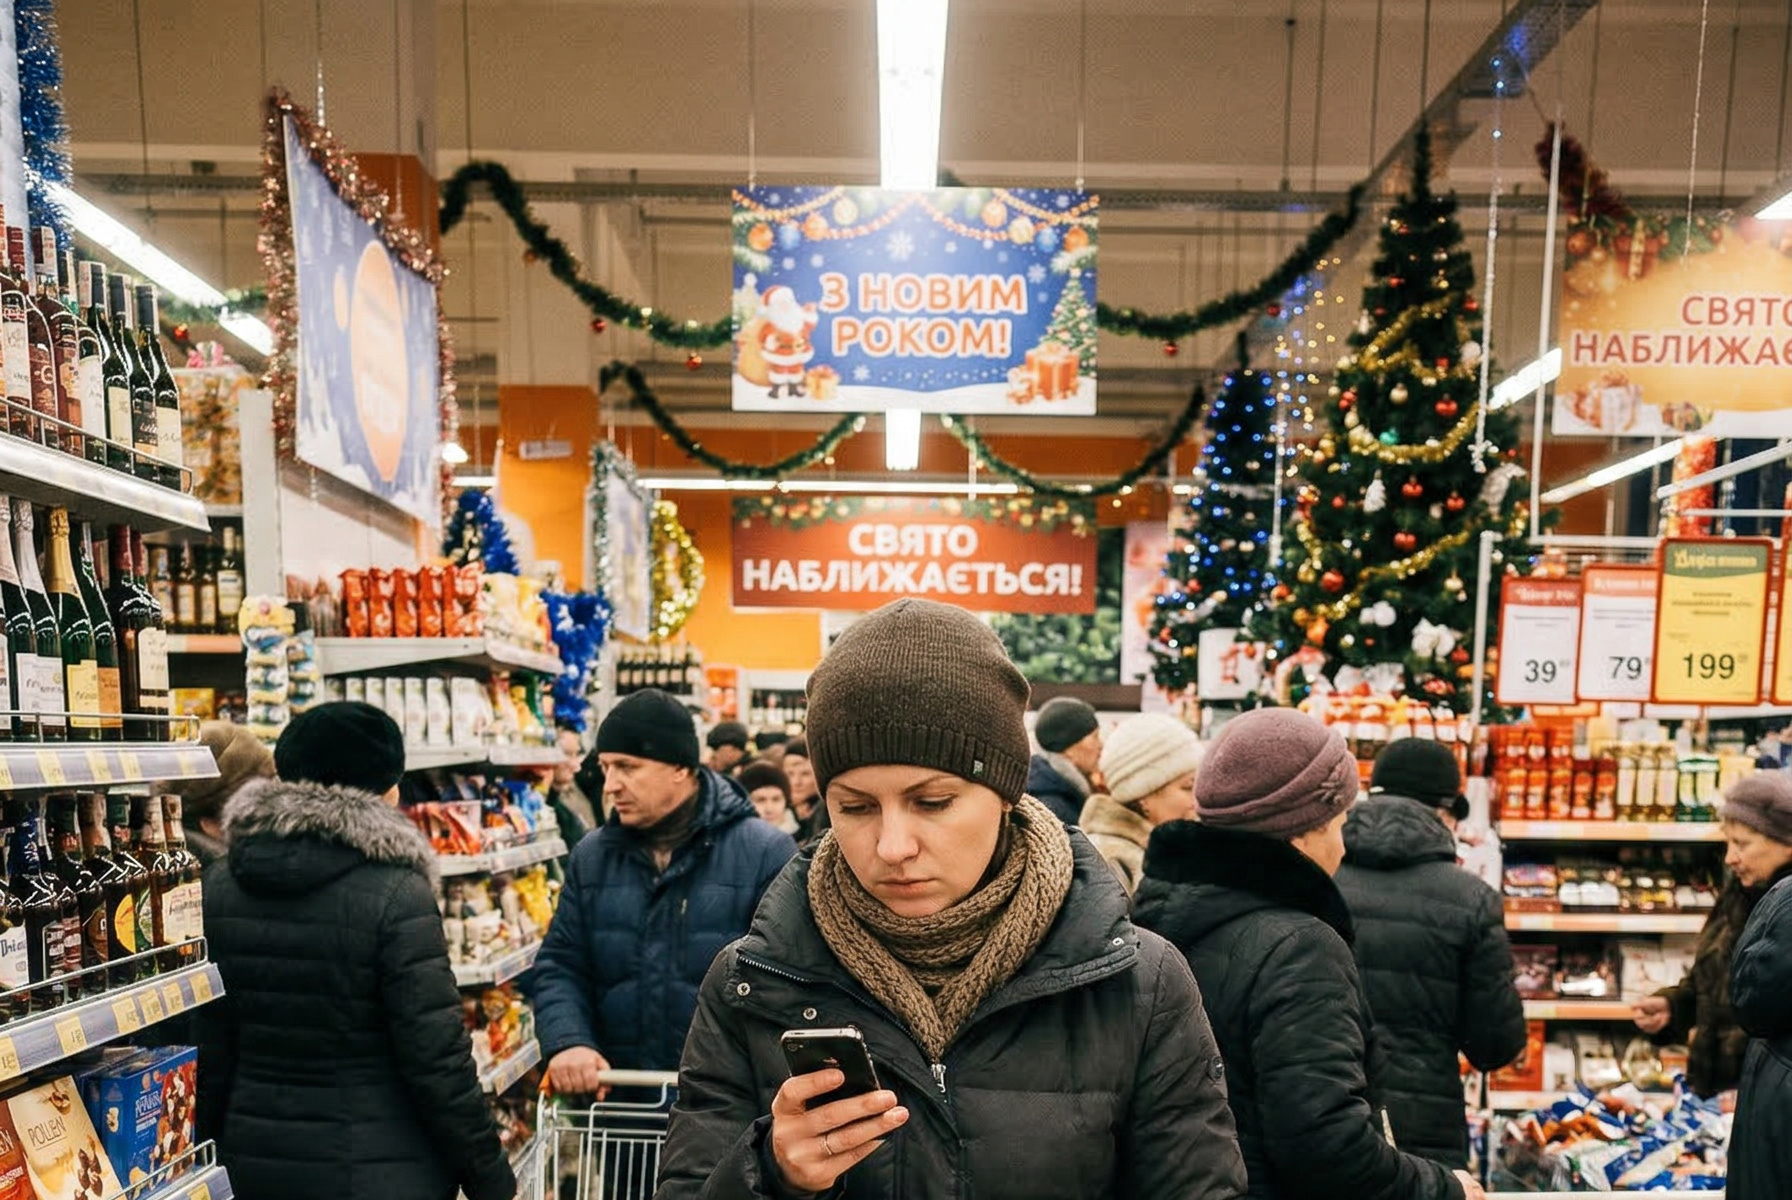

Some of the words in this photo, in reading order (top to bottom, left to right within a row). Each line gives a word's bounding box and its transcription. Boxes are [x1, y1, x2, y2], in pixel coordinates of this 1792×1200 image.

[820, 273, 849, 312] З
[860, 274, 1027, 314] НОВИМ
[833, 317, 1011, 357] РОКОМ!
[848, 523, 979, 557] СВЯТО
[742, 559, 1083, 596] НАБЛИЖАЄТЬСЯ!
[1523, 658, 1558, 684] 39
[1609, 655, 1642, 680] 79
[1683, 652, 1736, 680] 199
